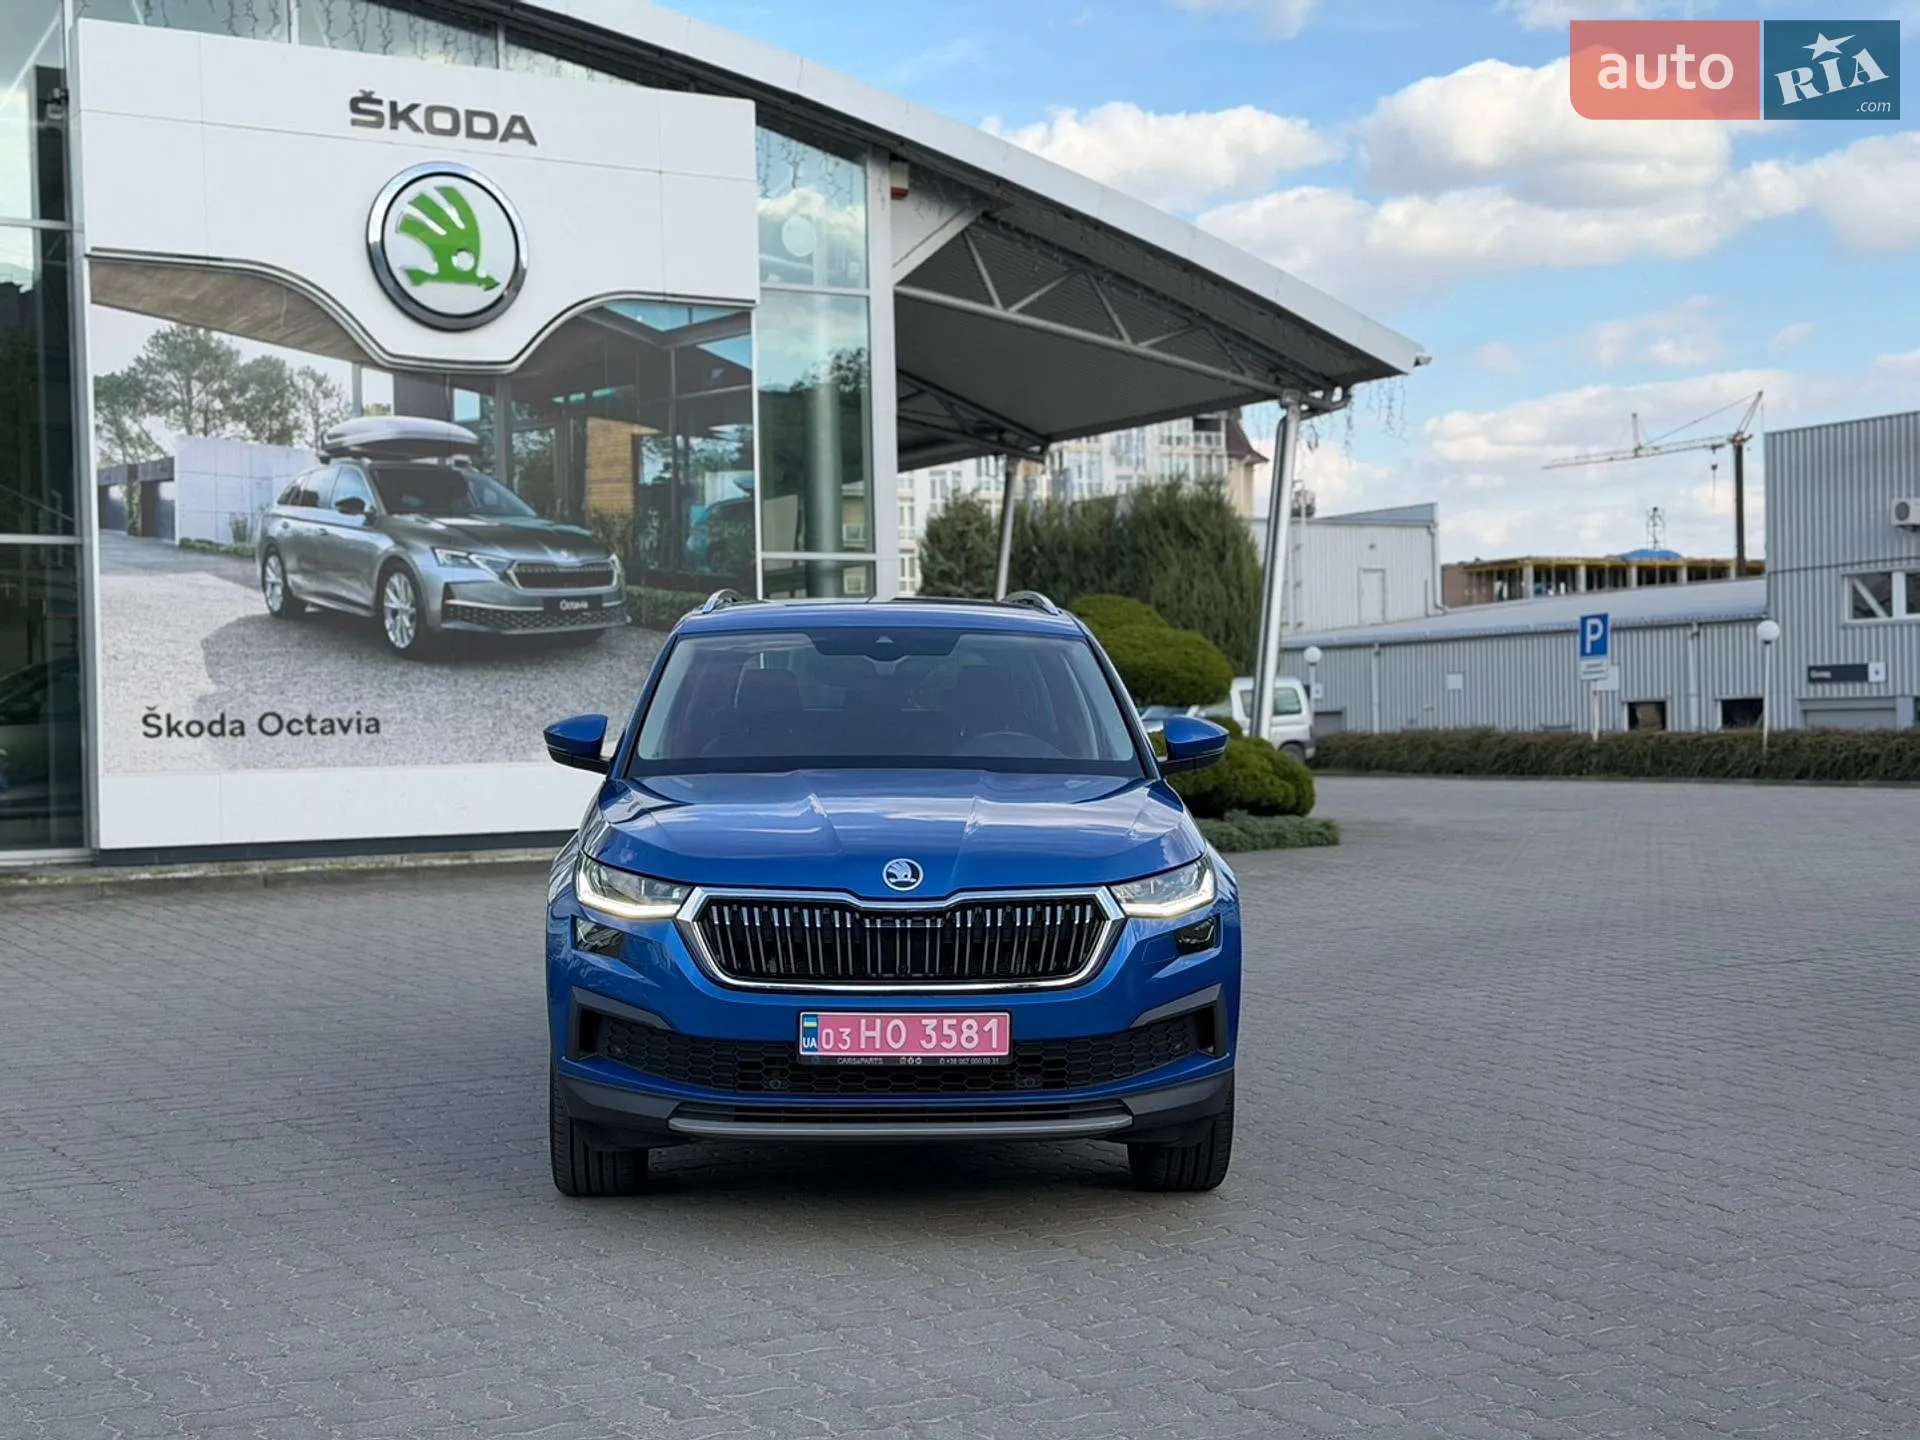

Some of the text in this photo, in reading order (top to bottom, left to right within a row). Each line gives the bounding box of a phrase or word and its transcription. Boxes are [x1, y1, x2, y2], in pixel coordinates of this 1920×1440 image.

[349, 89, 538, 147] ŠKODA
[1586, 618, 1604, 654] P
[142, 705, 381, 738] Škoda Octavia
[802, 1036, 817, 1048] UA
[821, 1018, 999, 1050] 03 HO 3581
